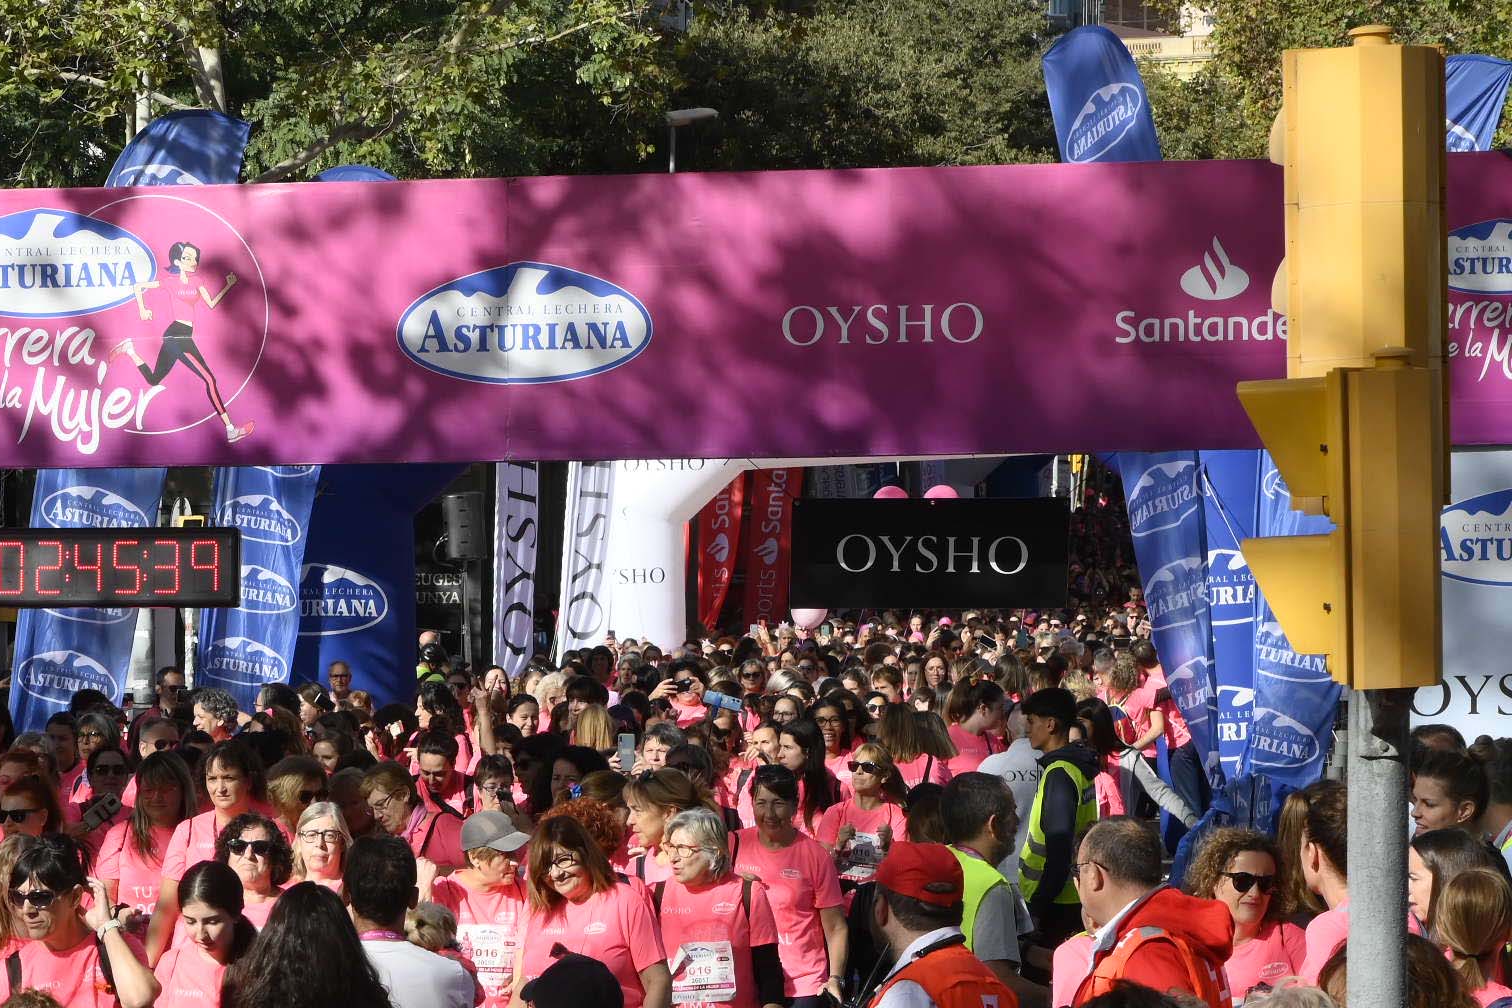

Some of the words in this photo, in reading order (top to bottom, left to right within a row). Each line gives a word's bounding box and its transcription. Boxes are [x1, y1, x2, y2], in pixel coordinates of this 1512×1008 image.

[59, 245, 133, 257] LECHERA
[457, 304, 535, 318] CENTRAL
[543, 302, 624, 316] LECHERA
[781, 302, 984, 347] OYSHO
[416, 309, 633, 354] ASTURIANA
[1115, 309, 1288, 344] Santande
[1464, 328, 1483, 358] la
[17, 354, 167, 455] Mujer
[761, 469, 787, 534] Santa
[1461, 523, 1512, 533] CENTR
[501, 461, 538, 657] OYSH
[565, 461, 611, 641] OYSH
[835, 533, 1030, 575] OYSHO
[612, 567, 666, 584] SHO
[240, 586, 292, 608] URIANA
[299, 597, 379, 619] URIANA
[416, 591, 461, 604] UNYA
[1259, 645, 1328, 673] TURIAN
[1410, 673, 1512, 717] OYS
[1250, 735, 1310, 760] URIANA
[1004, 768, 1043, 783] OYS
